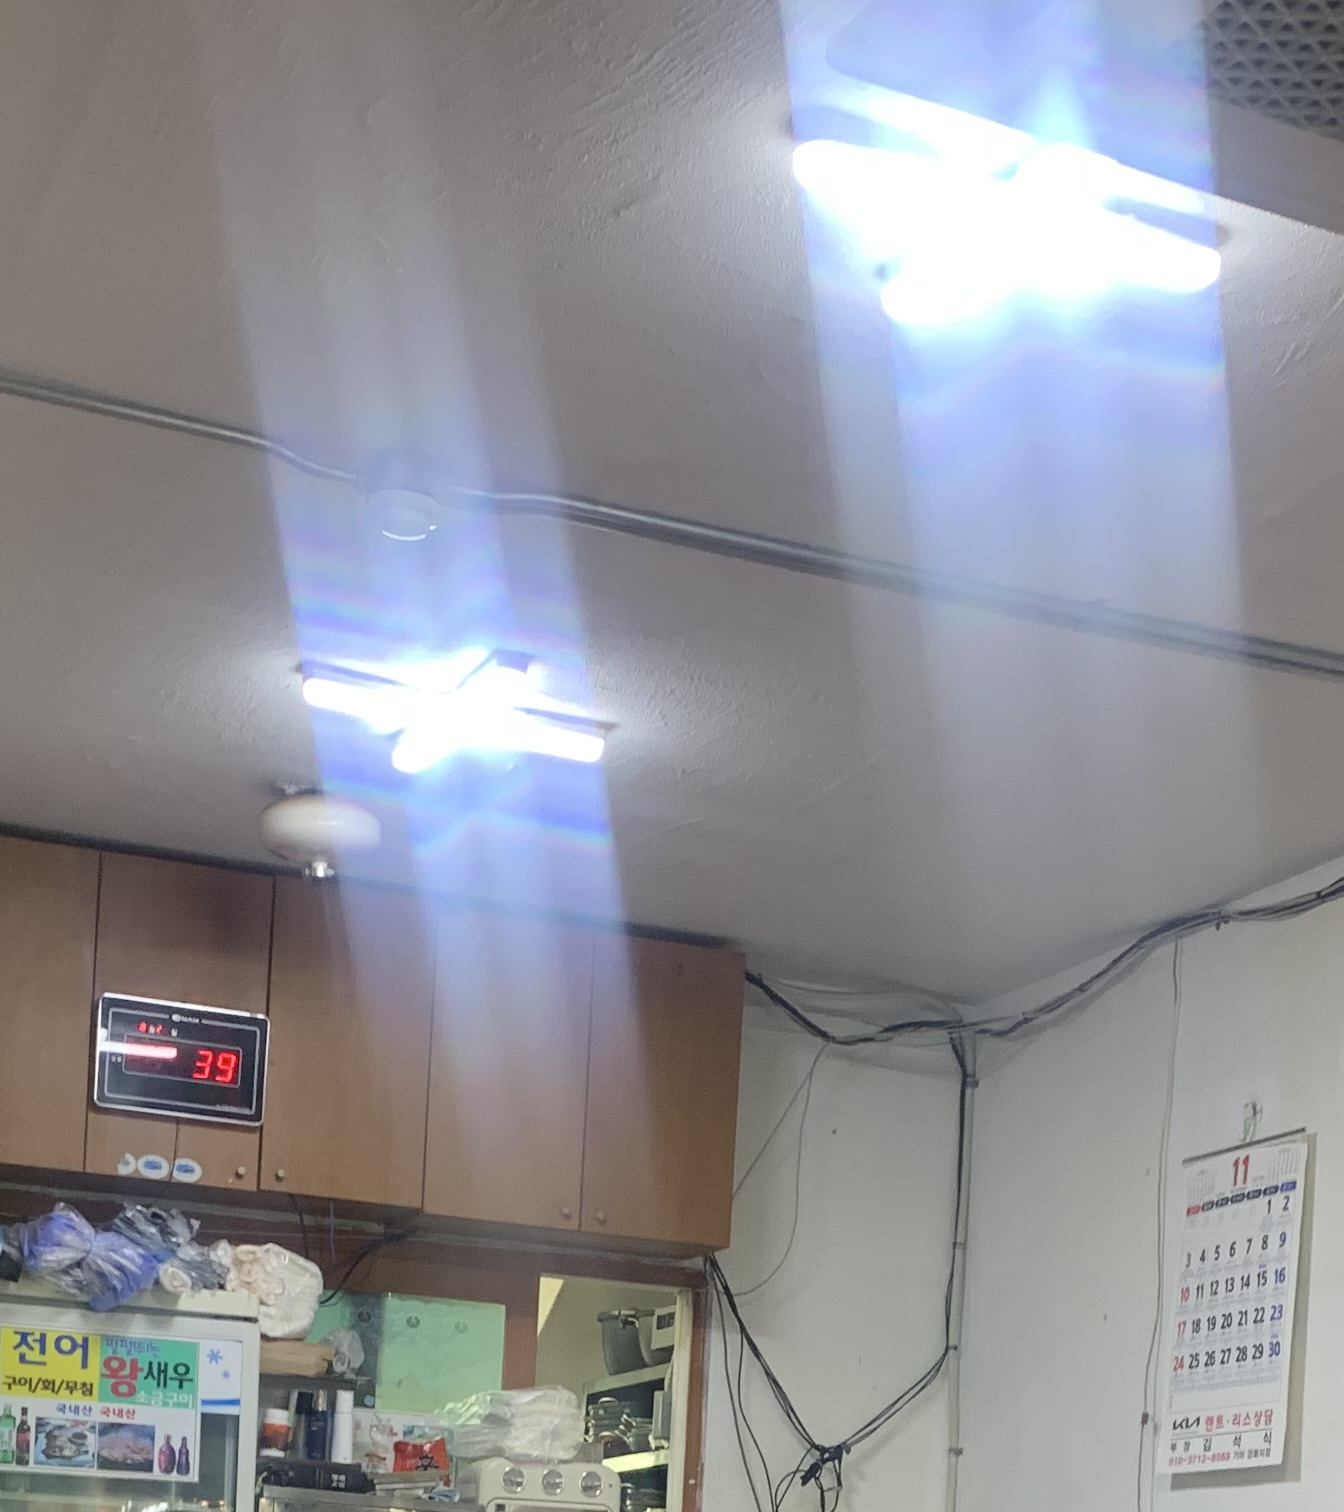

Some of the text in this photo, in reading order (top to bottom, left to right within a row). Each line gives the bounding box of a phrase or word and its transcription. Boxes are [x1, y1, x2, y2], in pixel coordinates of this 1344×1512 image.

[193, 1049, 237, 1083] 39
[1232, 1155, 1249, 1186] 11
[1267, 1199, 1272, 1214] 1
[1283, 1196, 1290, 1211] 2
[1185, 1232, 1286, 1268] 3 4 5 6 7 8 9
[1181, 1267, 1285, 1302] 10 11 12 13 14 15 16
[1178, 1305, 1283, 1338] 17 18 19 20 21 22 23
[13, 1331, 89, 1369] 전어
[1173, 1341, 1280, 1372] 24 25 26 27 28 29 30
[2, 1375, 93, 1397] 구이/회/무침
[101, 1356, 193, 1398] 왕새우
[56, 1403, 135, 1419] 국내산 국내산
[137, 1390, 193, 1408] 소금구이
